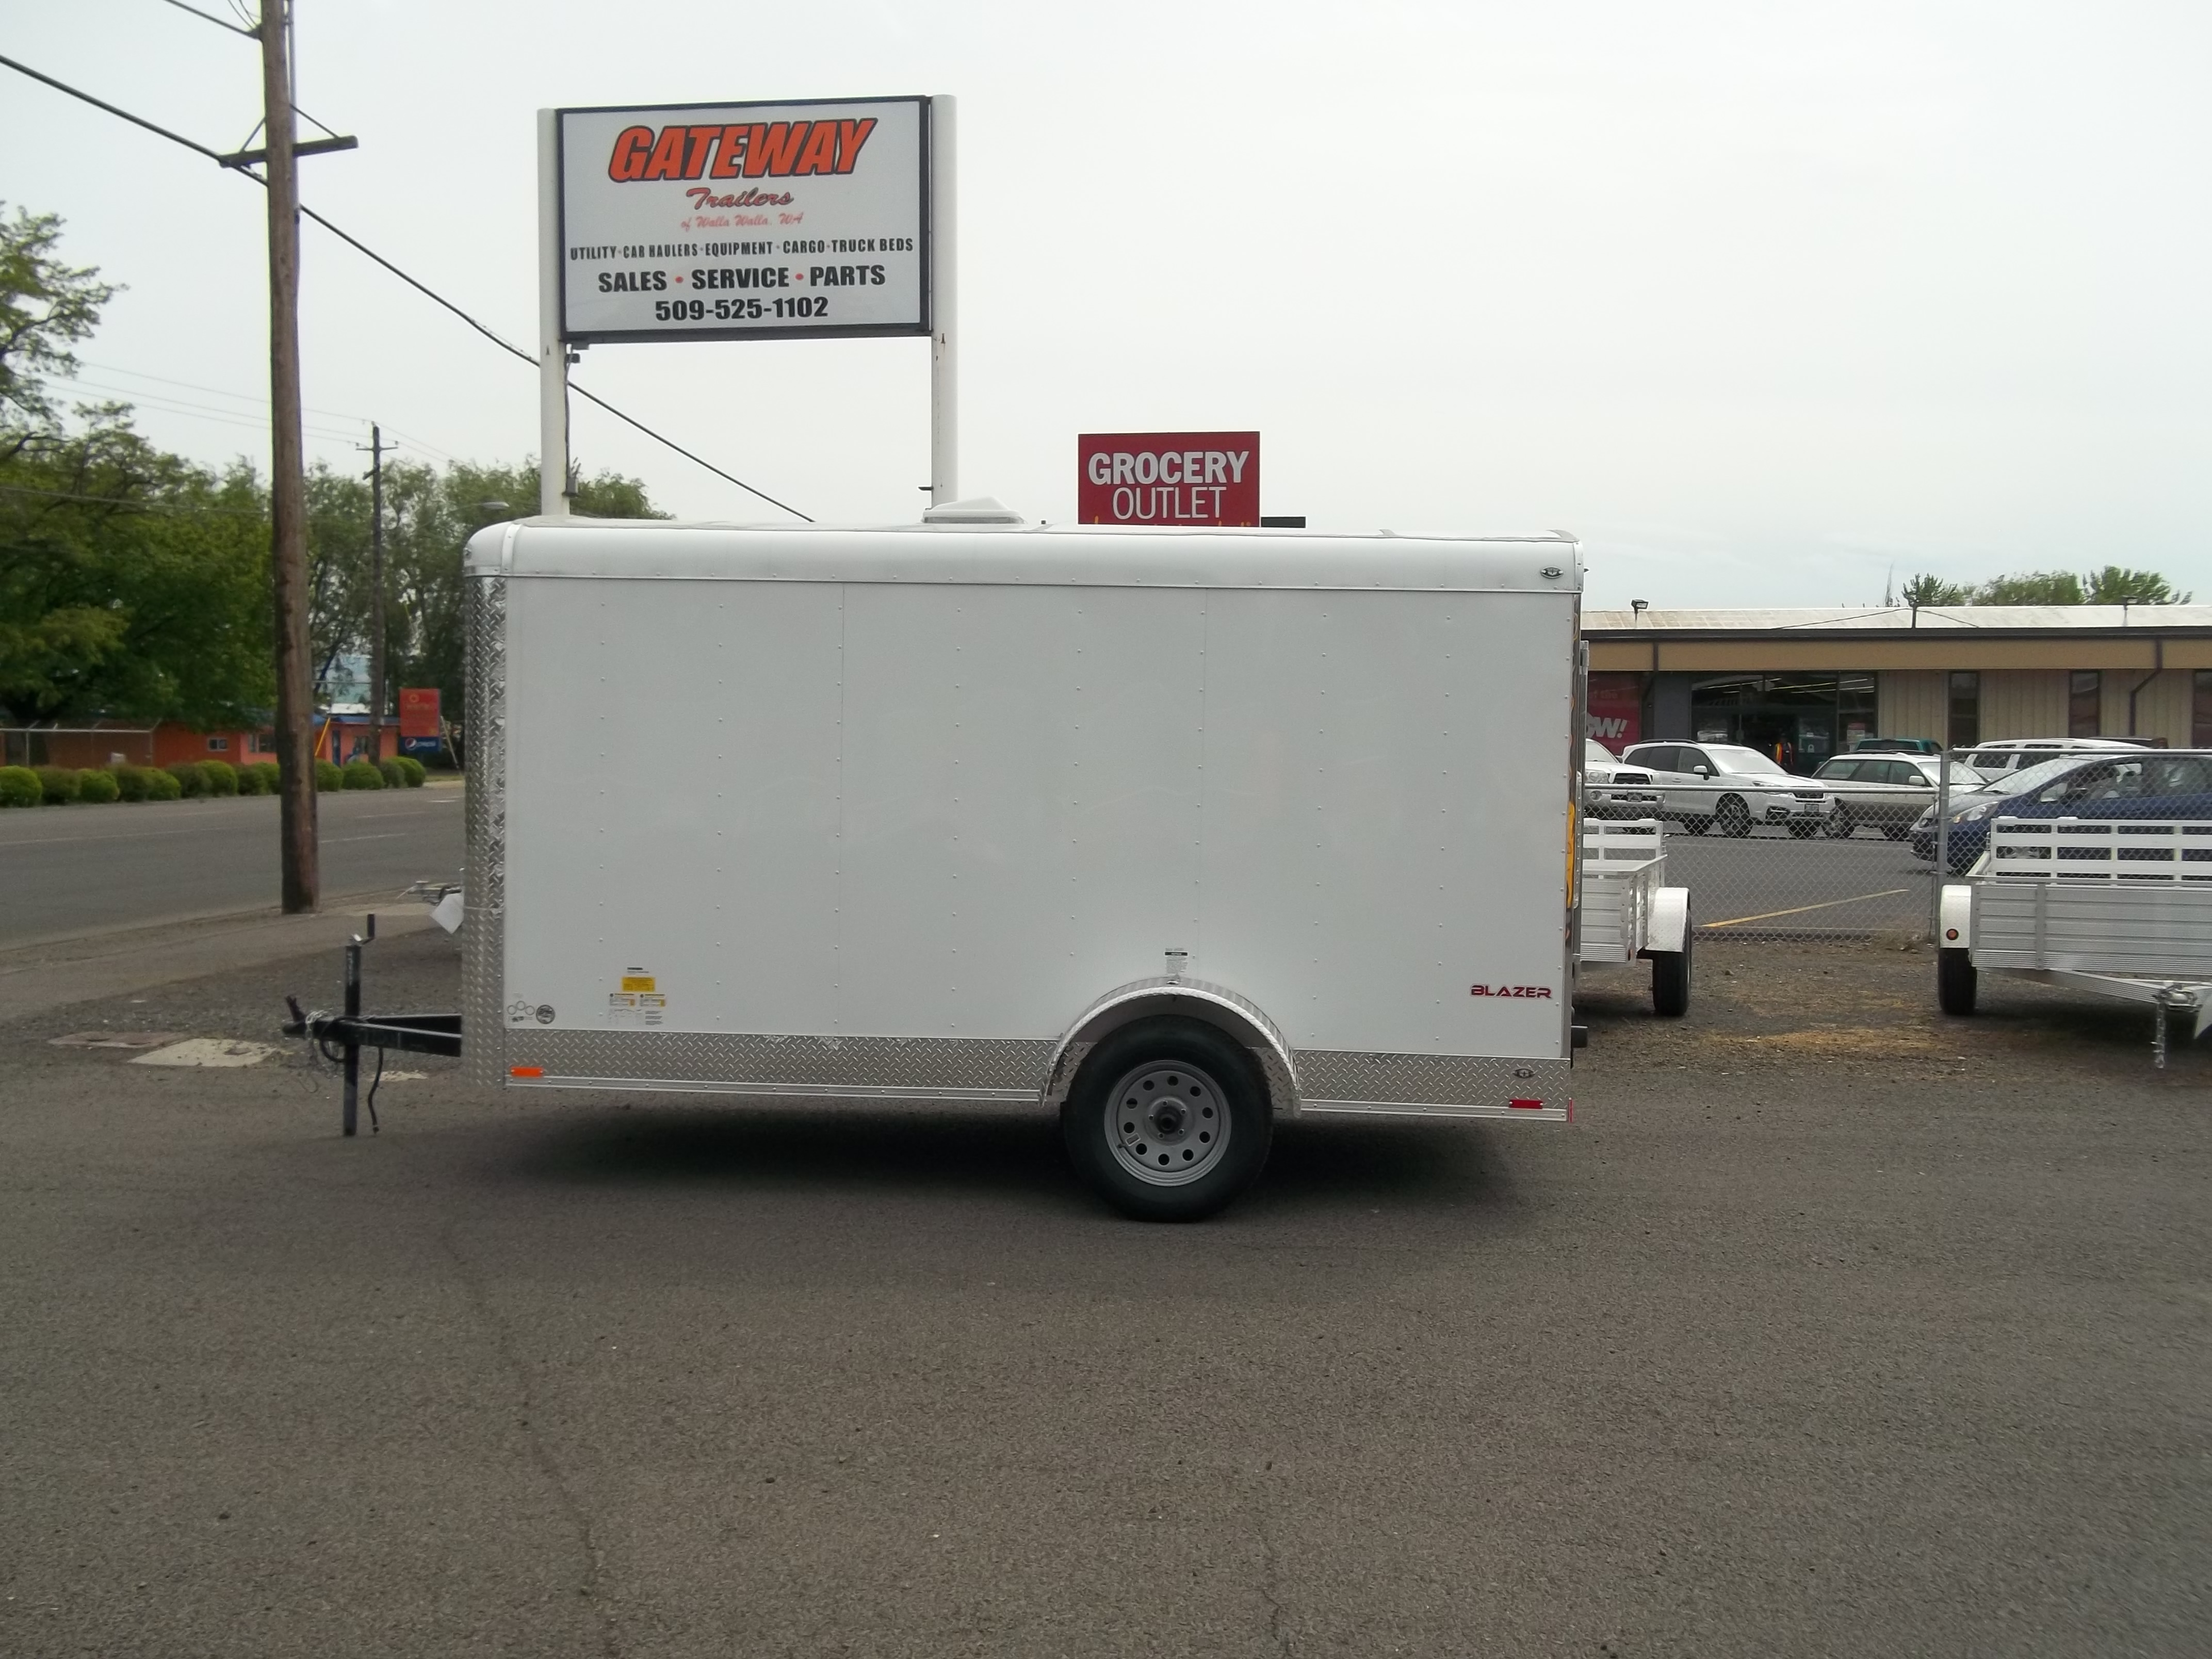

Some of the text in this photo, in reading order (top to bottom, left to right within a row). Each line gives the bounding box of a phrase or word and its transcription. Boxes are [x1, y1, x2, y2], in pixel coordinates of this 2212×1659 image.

[608, 118, 877, 183] GATEWAY
[686, 187, 794, 210] Trailers
[680, 217, 692, 232] of
[695, 215, 730, 228] Walla
[779, 211, 804, 225] WA
[570, 238, 913, 260] UTILITY CAR HAULERS EQUIPMENT CARGO TRUCK BEDS
[598, 265, 886, 292] SALES SERVICE PARTS
[655, 297, 828, 321] 509-525-1102
[1088, 451, 1249, 485] GROCERY
[1112, 486, 1227, 519] OUTLET
[1471, 985, 1552, 999] BLAZER
